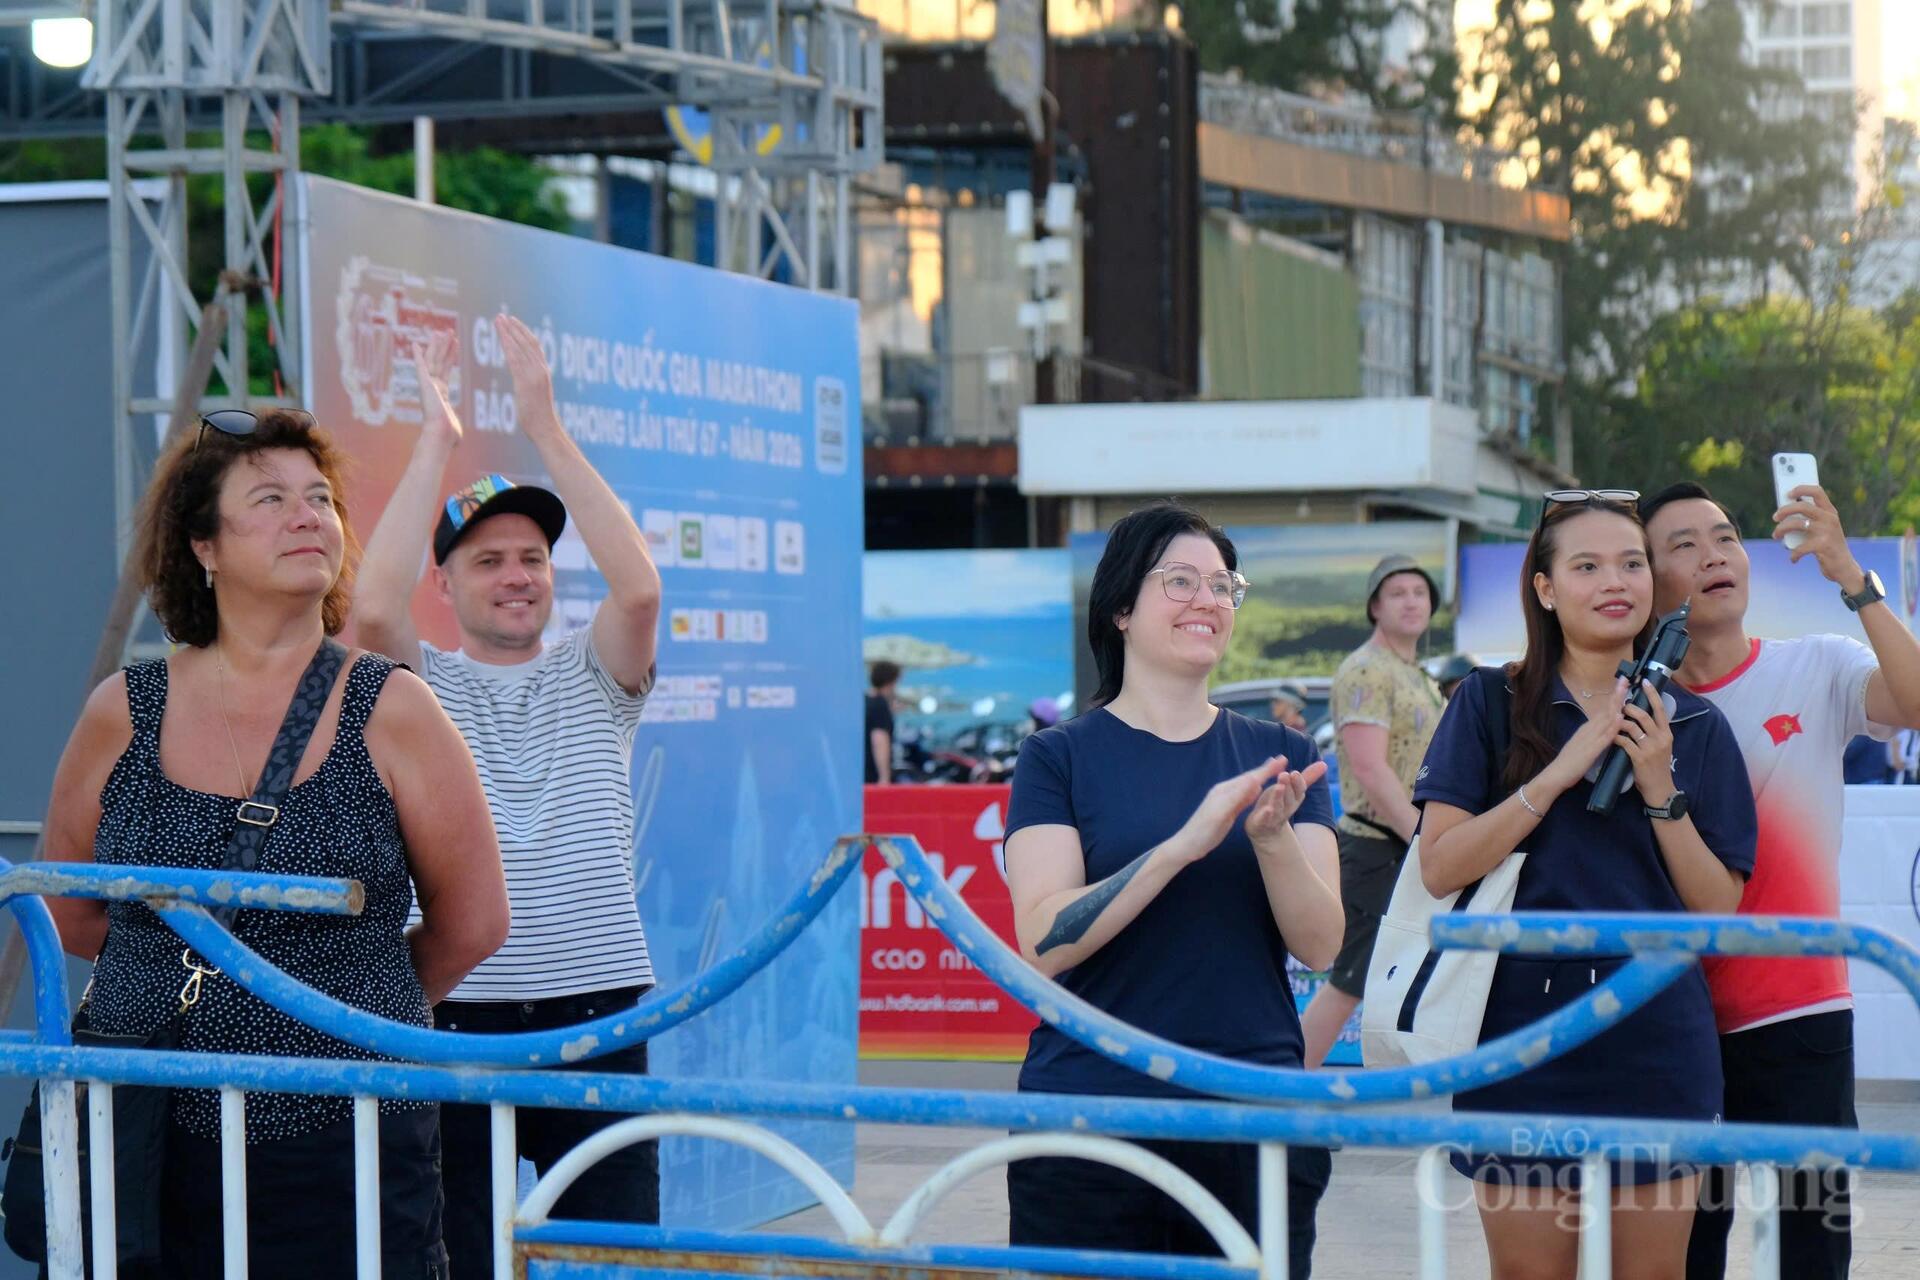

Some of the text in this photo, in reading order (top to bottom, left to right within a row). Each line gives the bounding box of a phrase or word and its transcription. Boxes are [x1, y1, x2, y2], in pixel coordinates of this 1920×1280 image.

[473, 380, 516, 433] BÁO
[669, 350, 702, 398] GIA
[706, 358, 803, 415] MARATHON
[871, 948, 927, 971] cao
